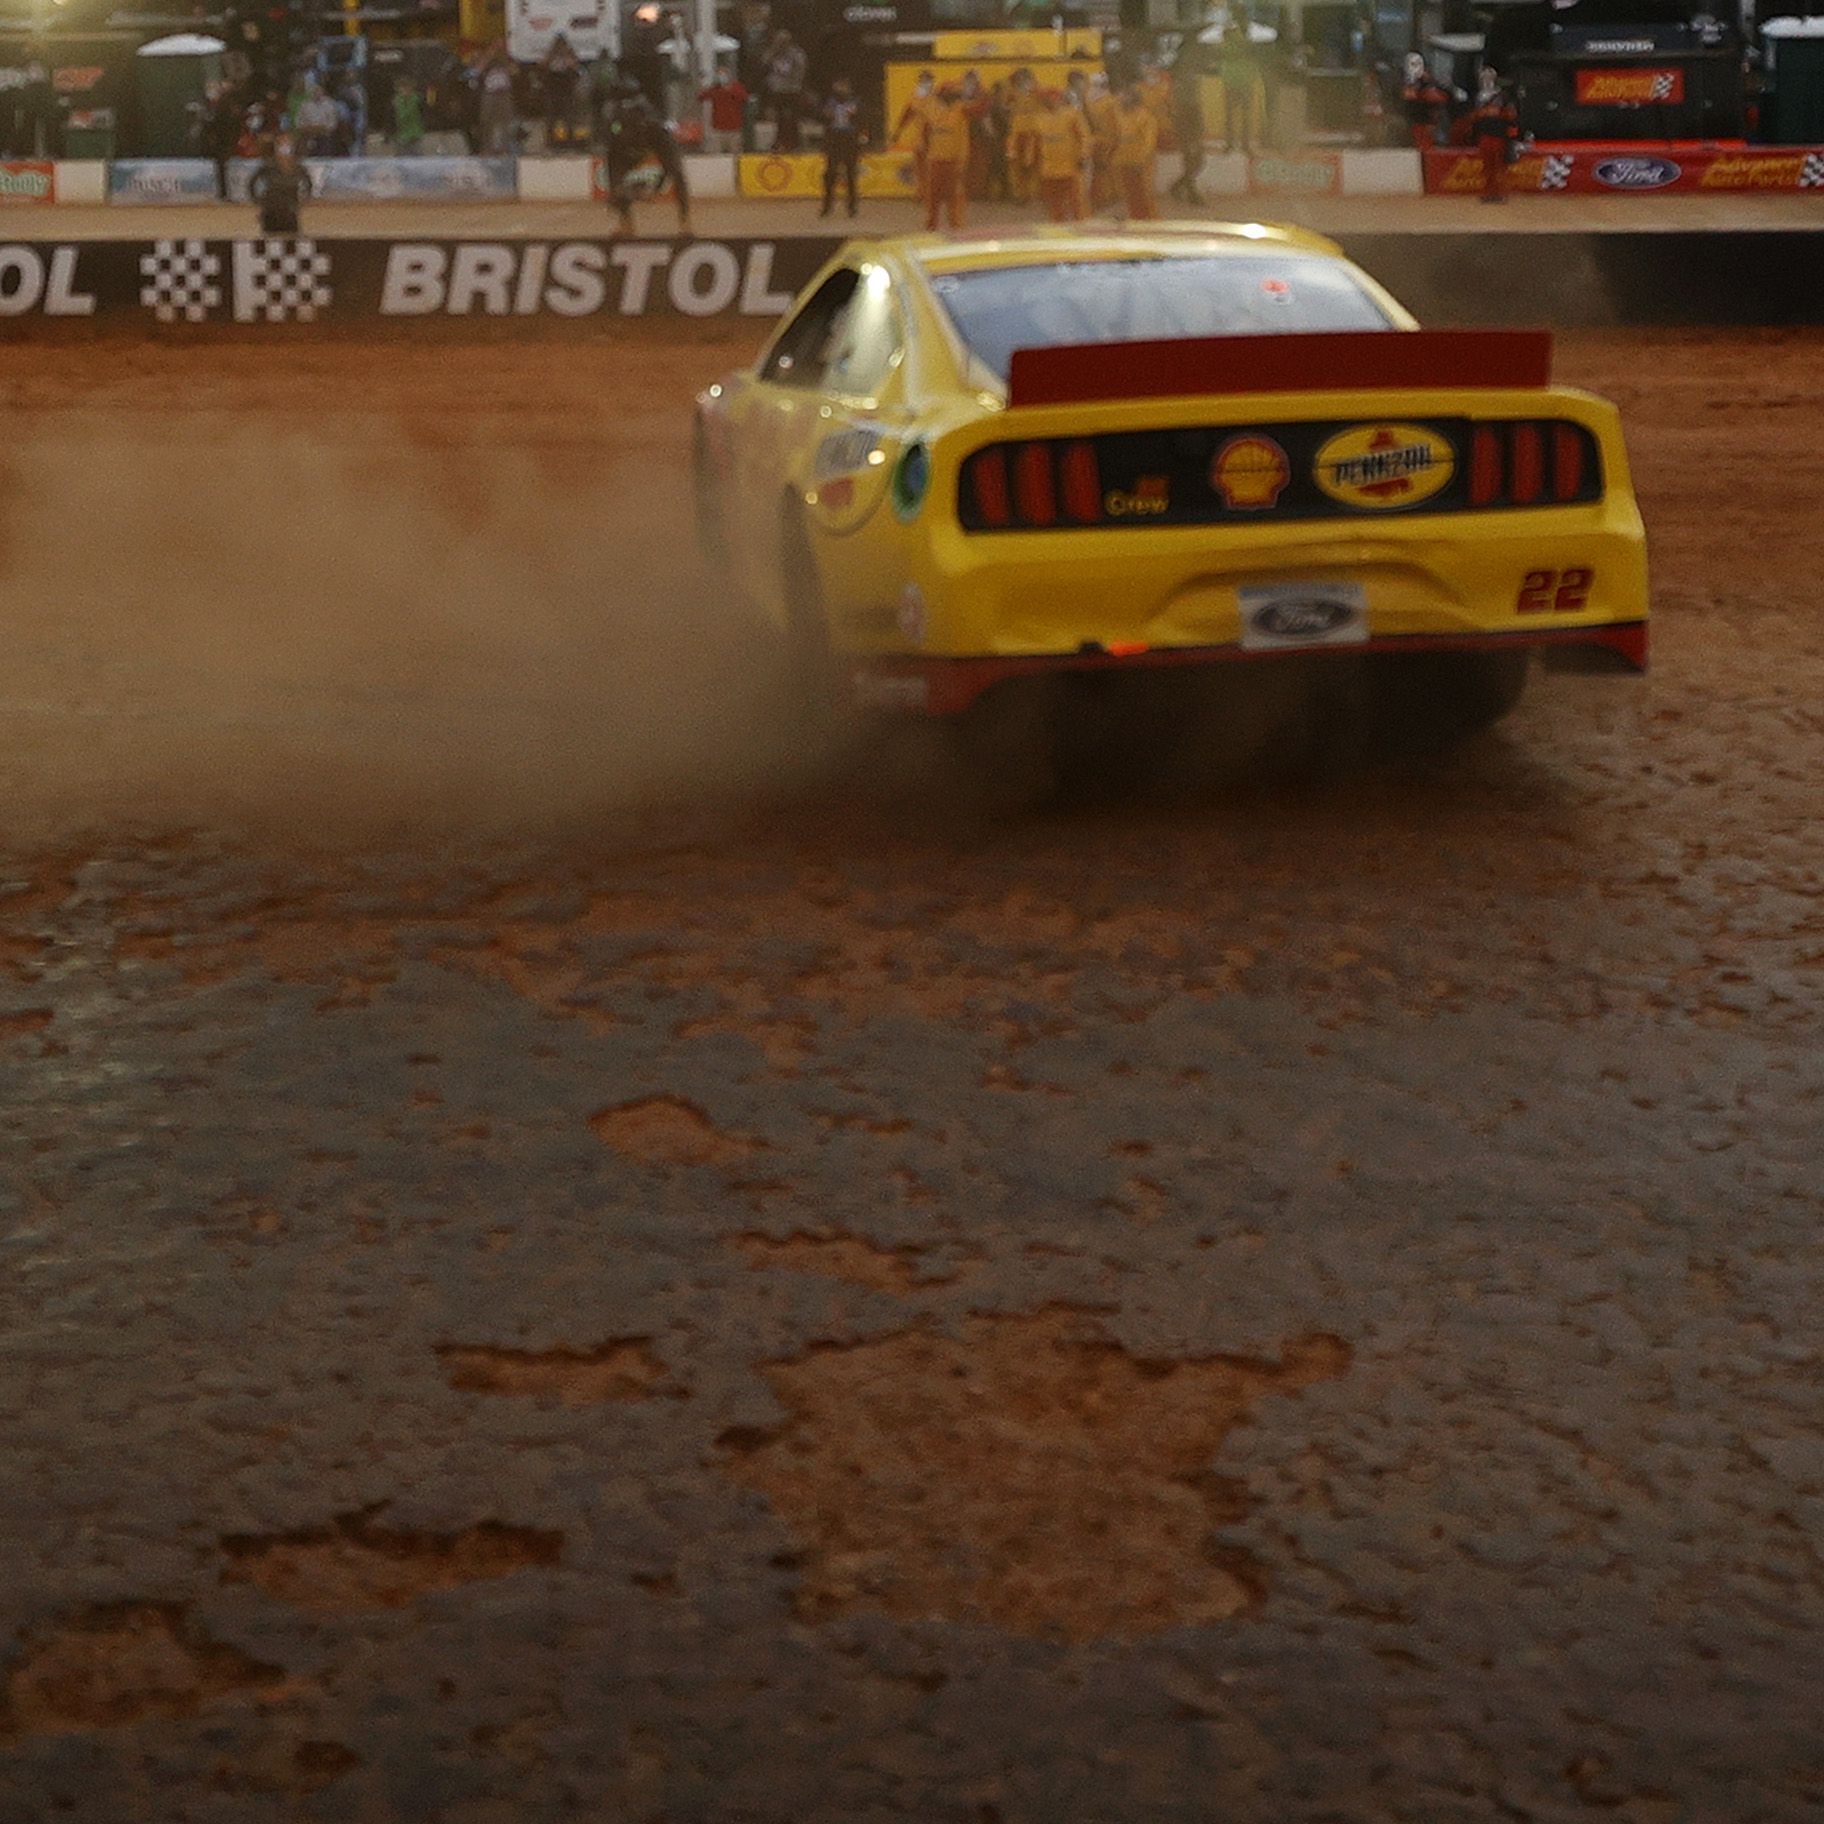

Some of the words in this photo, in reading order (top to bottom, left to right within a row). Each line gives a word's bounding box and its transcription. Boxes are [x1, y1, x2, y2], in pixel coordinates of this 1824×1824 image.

[1609, 157, 1666, 183] Ford
[379, 242, 795, 317] BRISTOL
[1334, 443, 1433, 487] PENNZOIL
[1104, 489, 1170, 517] Crew
[1516, 567, 1594, 615] 22
